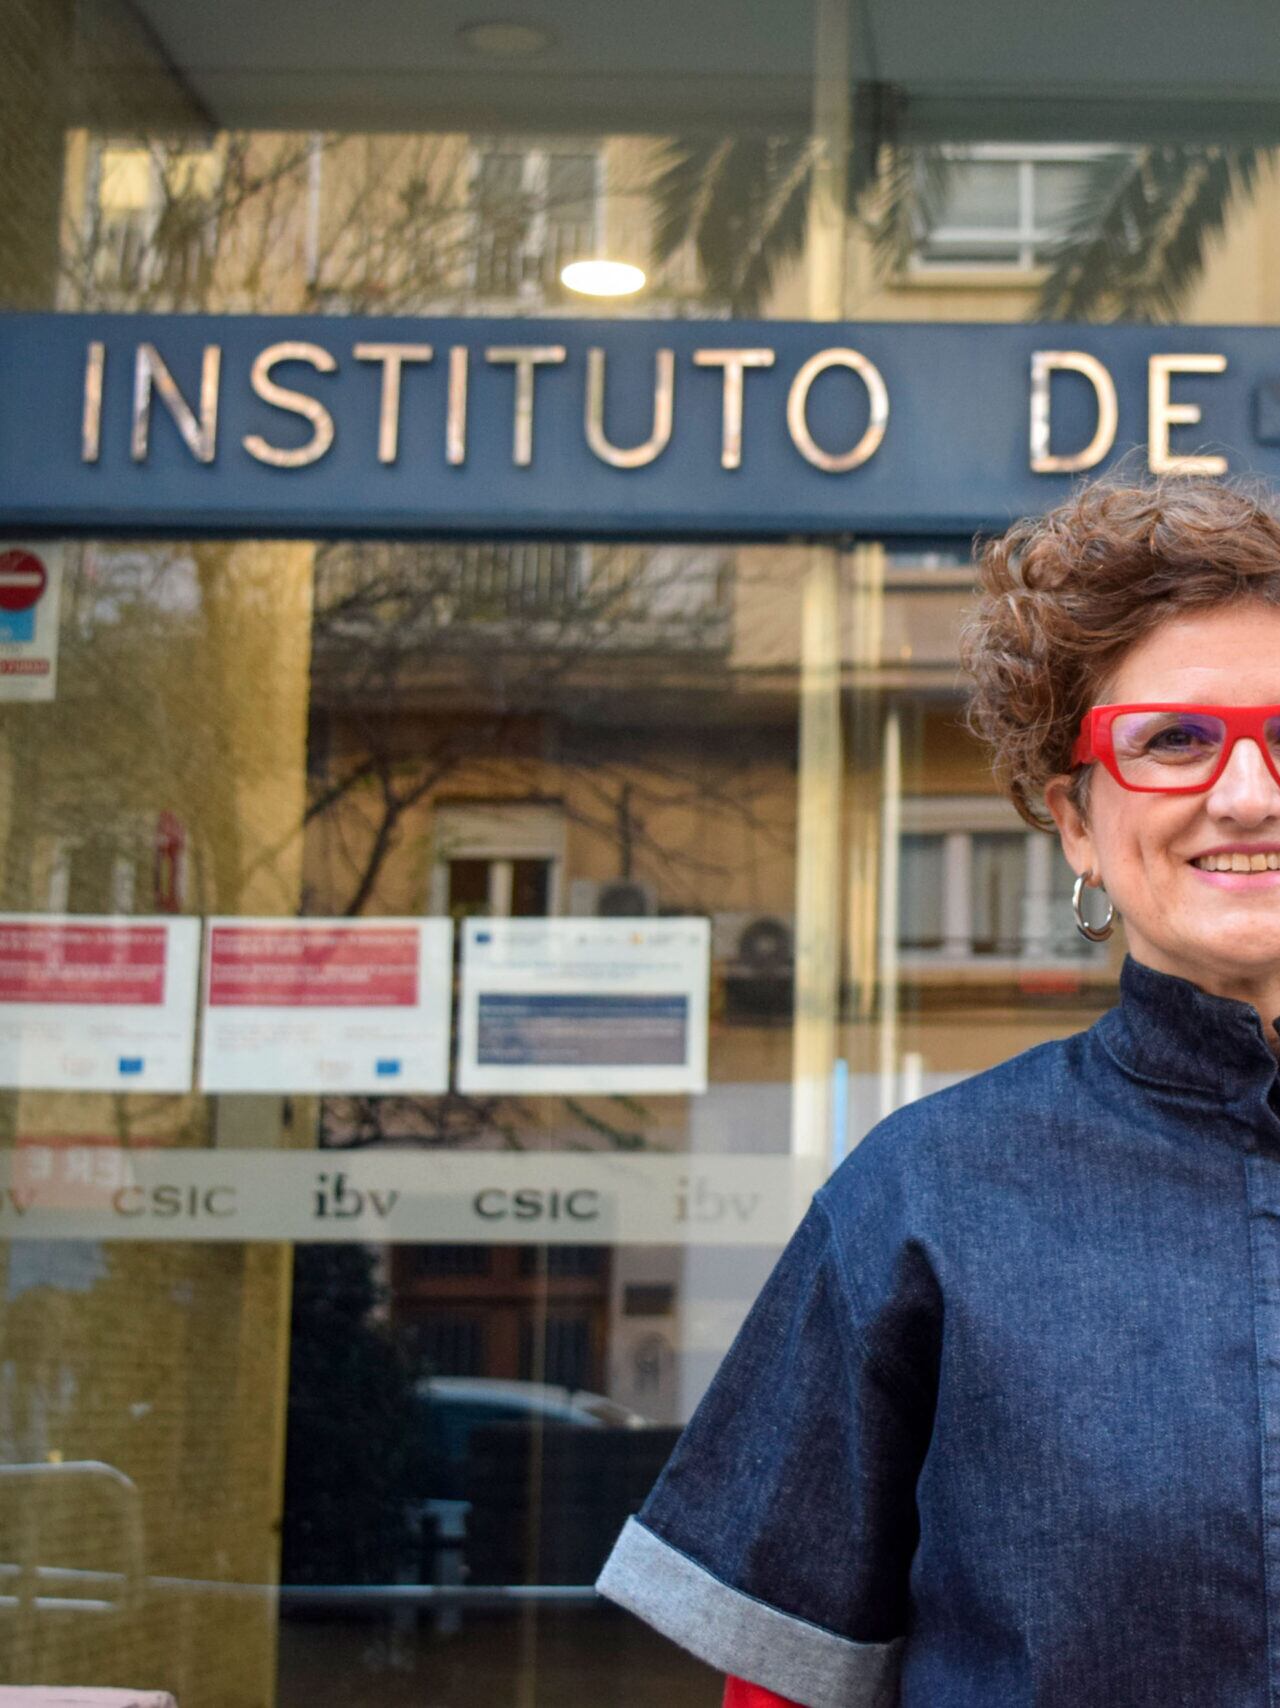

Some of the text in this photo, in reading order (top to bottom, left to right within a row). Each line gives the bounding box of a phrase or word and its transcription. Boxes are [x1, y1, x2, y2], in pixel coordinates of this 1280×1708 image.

[80, 341, 890, 475] INSTITUTO
[1031, 351, 1229, 476] DE
[113, 1185, 237, 1217] CSIC
[313, 1173, 398, 1219] ibv
[473, 1188, 599, 1221] CSIC
